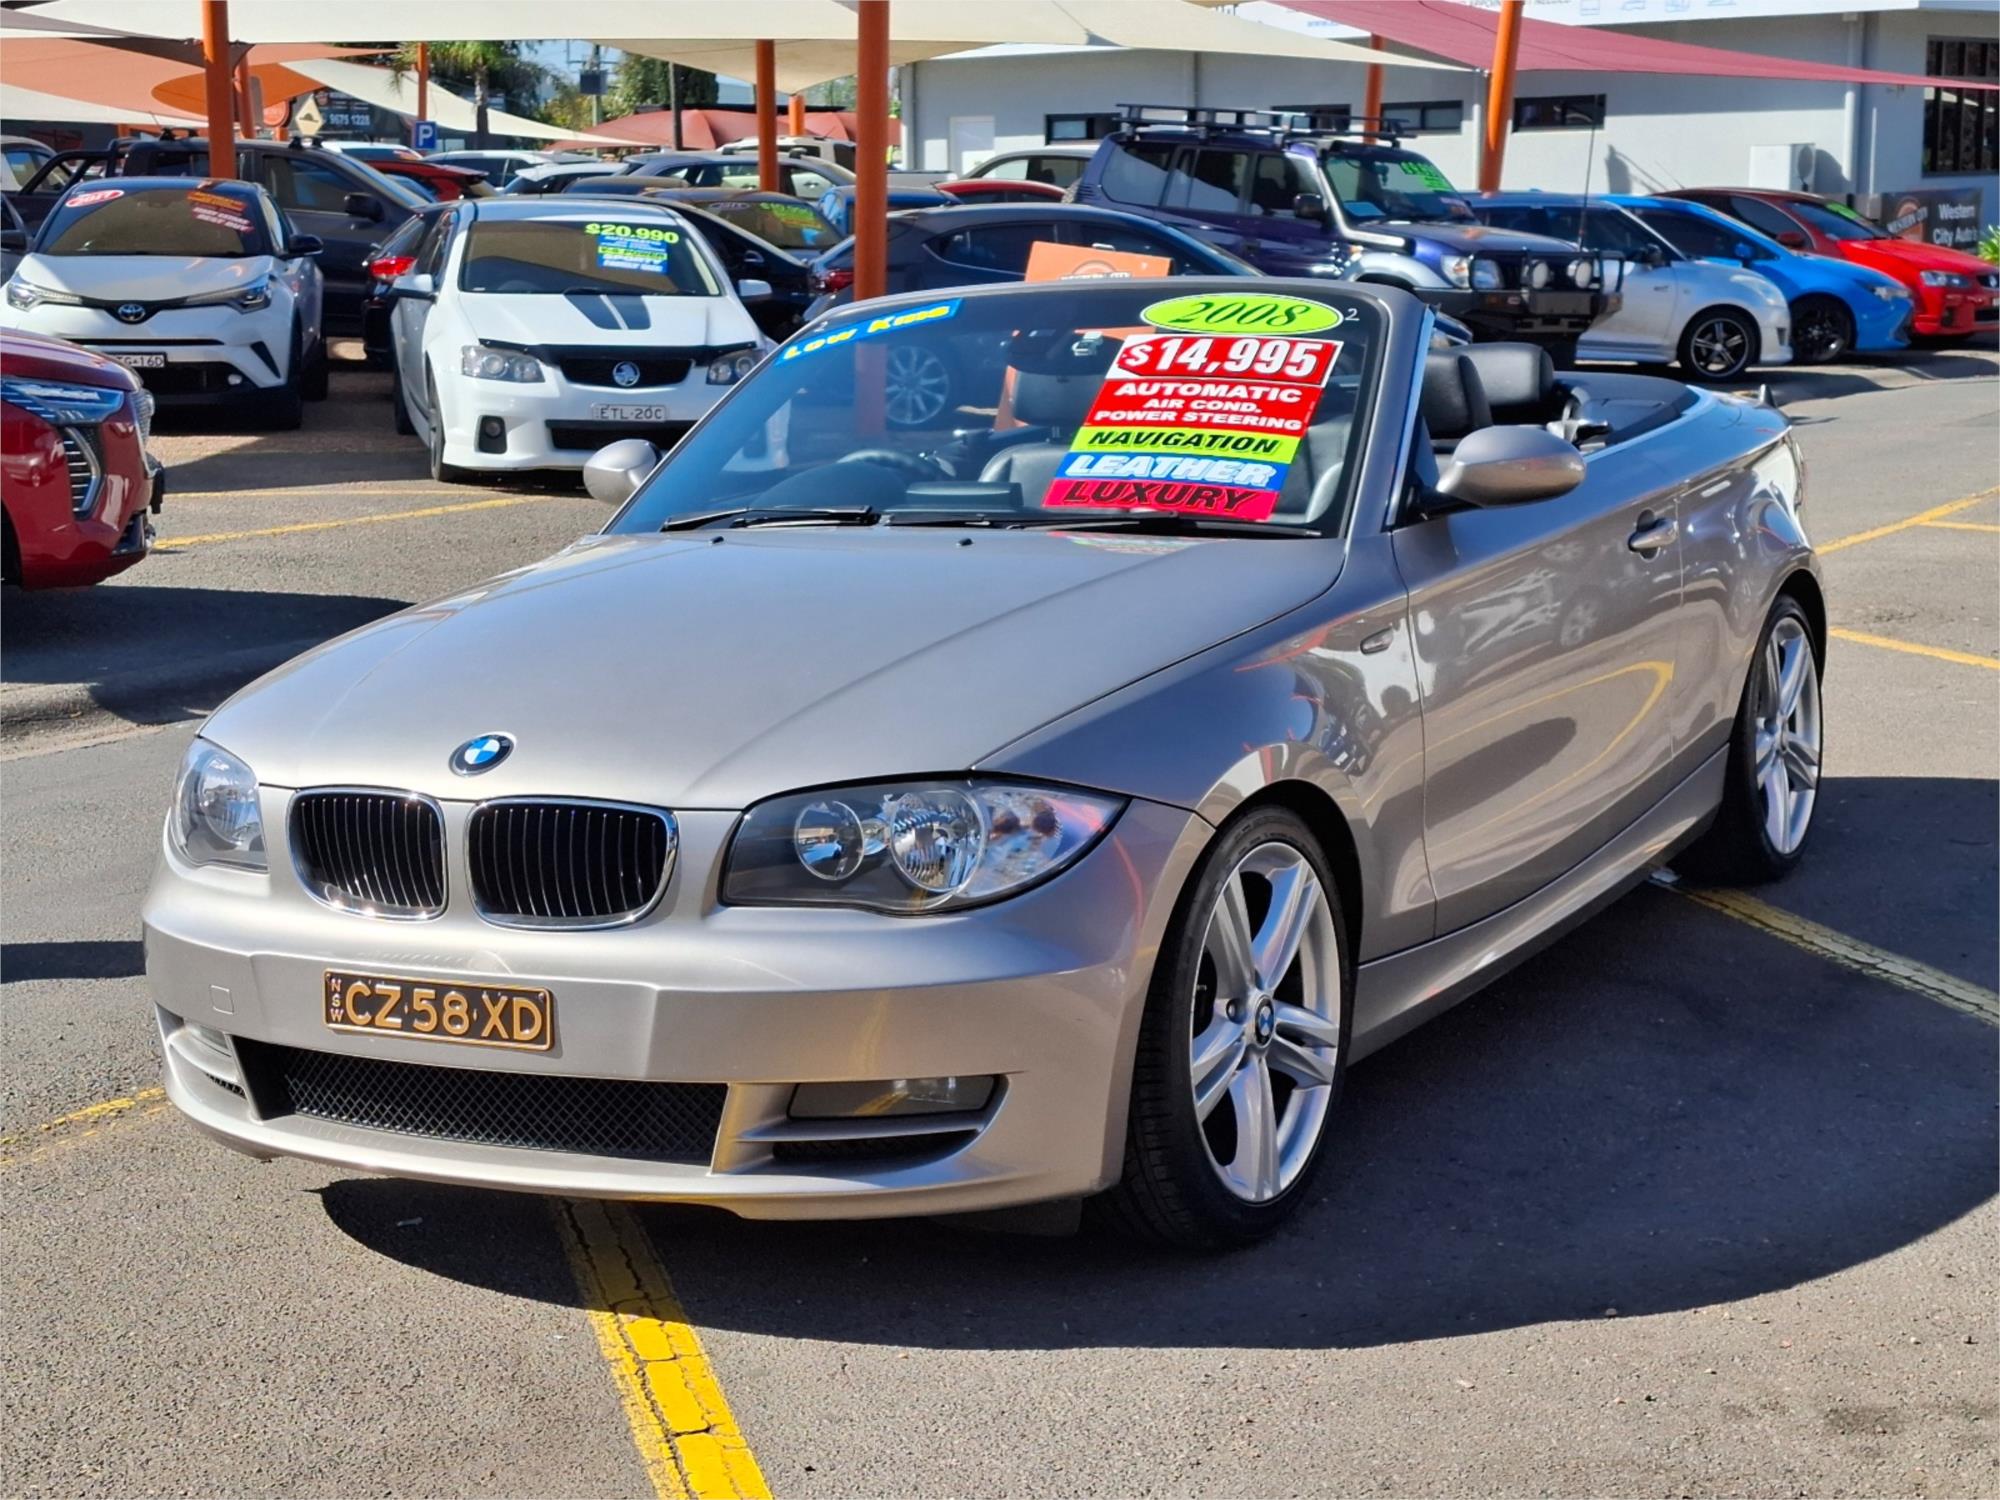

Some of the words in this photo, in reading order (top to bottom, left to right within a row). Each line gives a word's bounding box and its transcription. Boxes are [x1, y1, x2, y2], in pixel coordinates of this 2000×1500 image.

[419, 125, 433, 147] P
[1938, 203, 1975, 221] Western
[1932, 227, 1954, 247] City
[1168, 302, 1311, 327] 2008
[1124, 337, 1324, 377] $14,995
[1114, 382, 1303, 403] AUTOMATIC
[1143, 398, 1185, 409] AIR
[1190, 399, 1263, 414] COND.
[1094, 410, 1177, 423] POWER
[1181, 411, 1303, 431] STEERING
[1087, 431, 1280, 454] NAVIGATION
[1065, 454, 1278, 488] LEATHER
[1064, 481, 1258, 512] LUXURY
